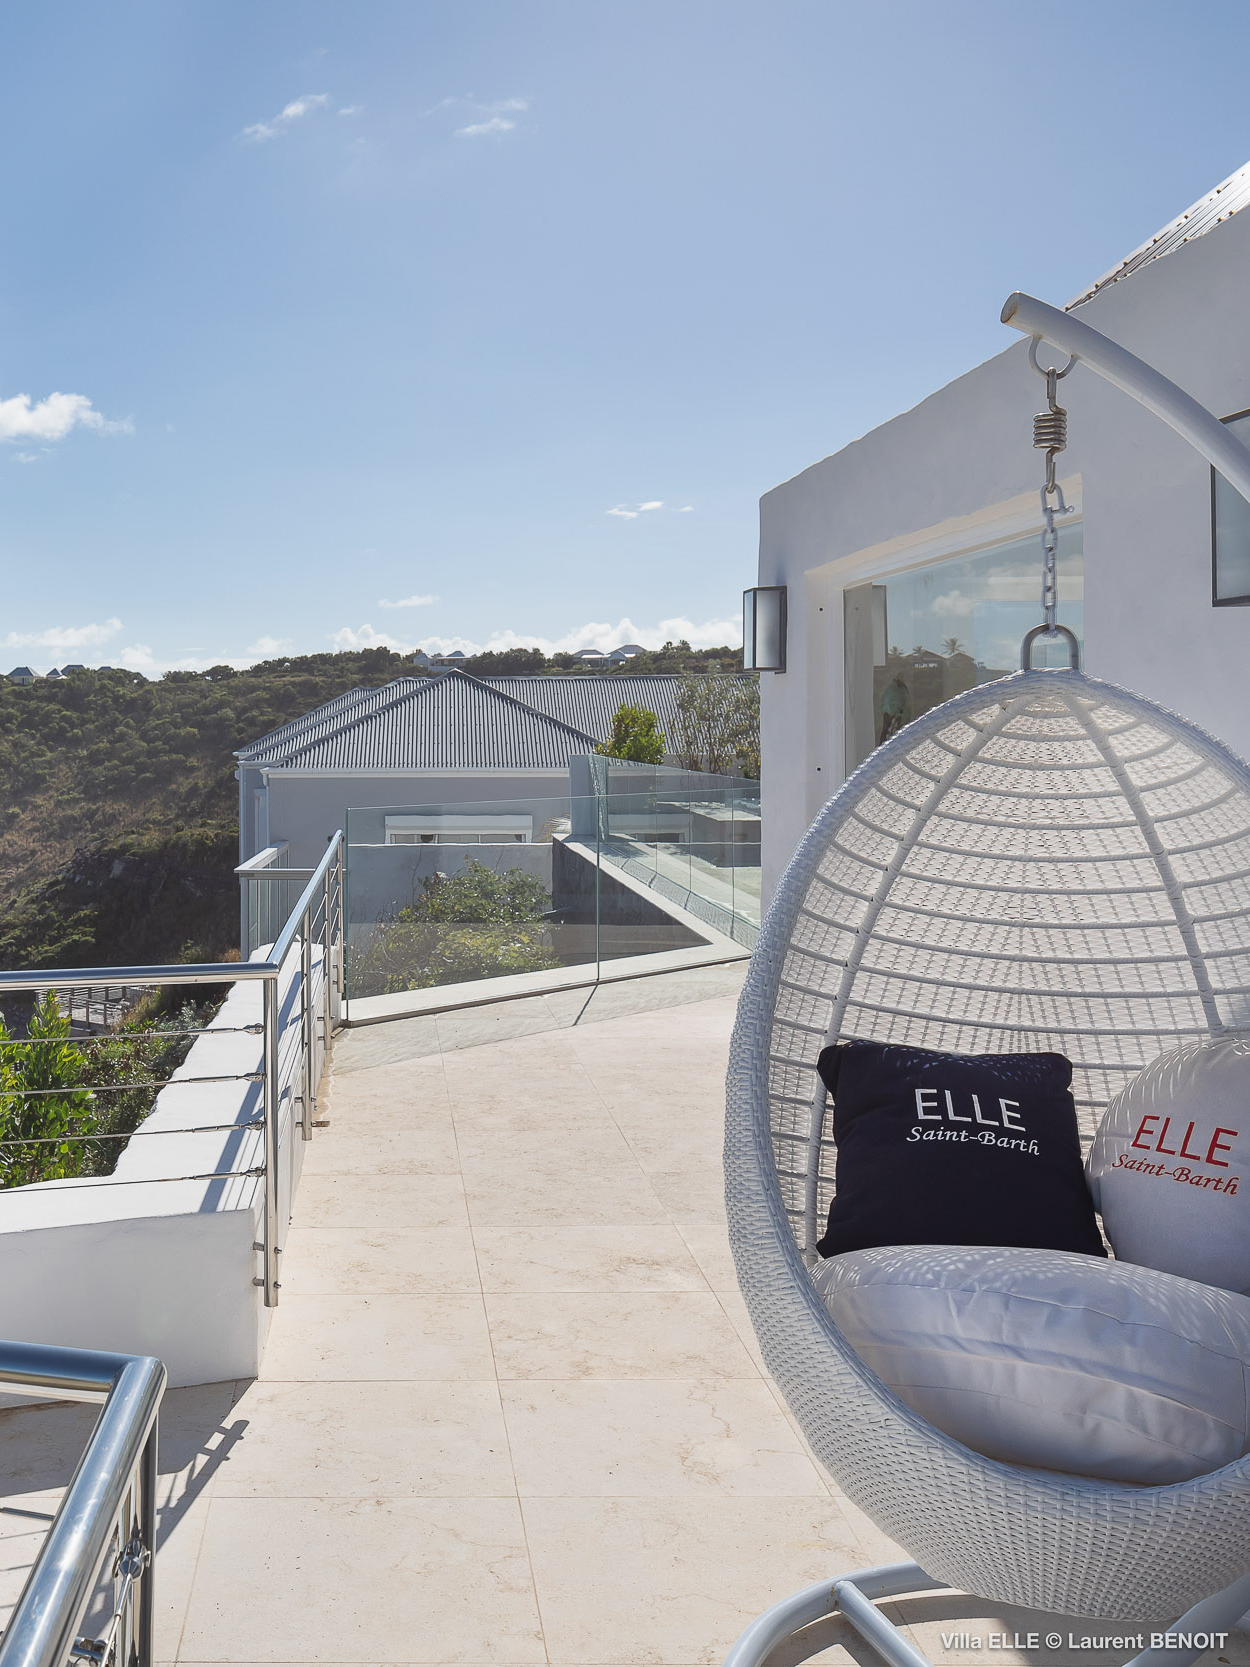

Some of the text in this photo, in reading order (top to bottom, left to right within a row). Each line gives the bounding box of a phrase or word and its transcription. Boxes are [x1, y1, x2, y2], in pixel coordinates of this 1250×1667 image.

[915, 1088, 1026, 1132] ELLE
[906, 1125, 1040, 1156] Saint-Barth
[1130, 1115, 1239, 1168] ELLE
[1111, 1152, 1240, 1196] Saint-Barth
